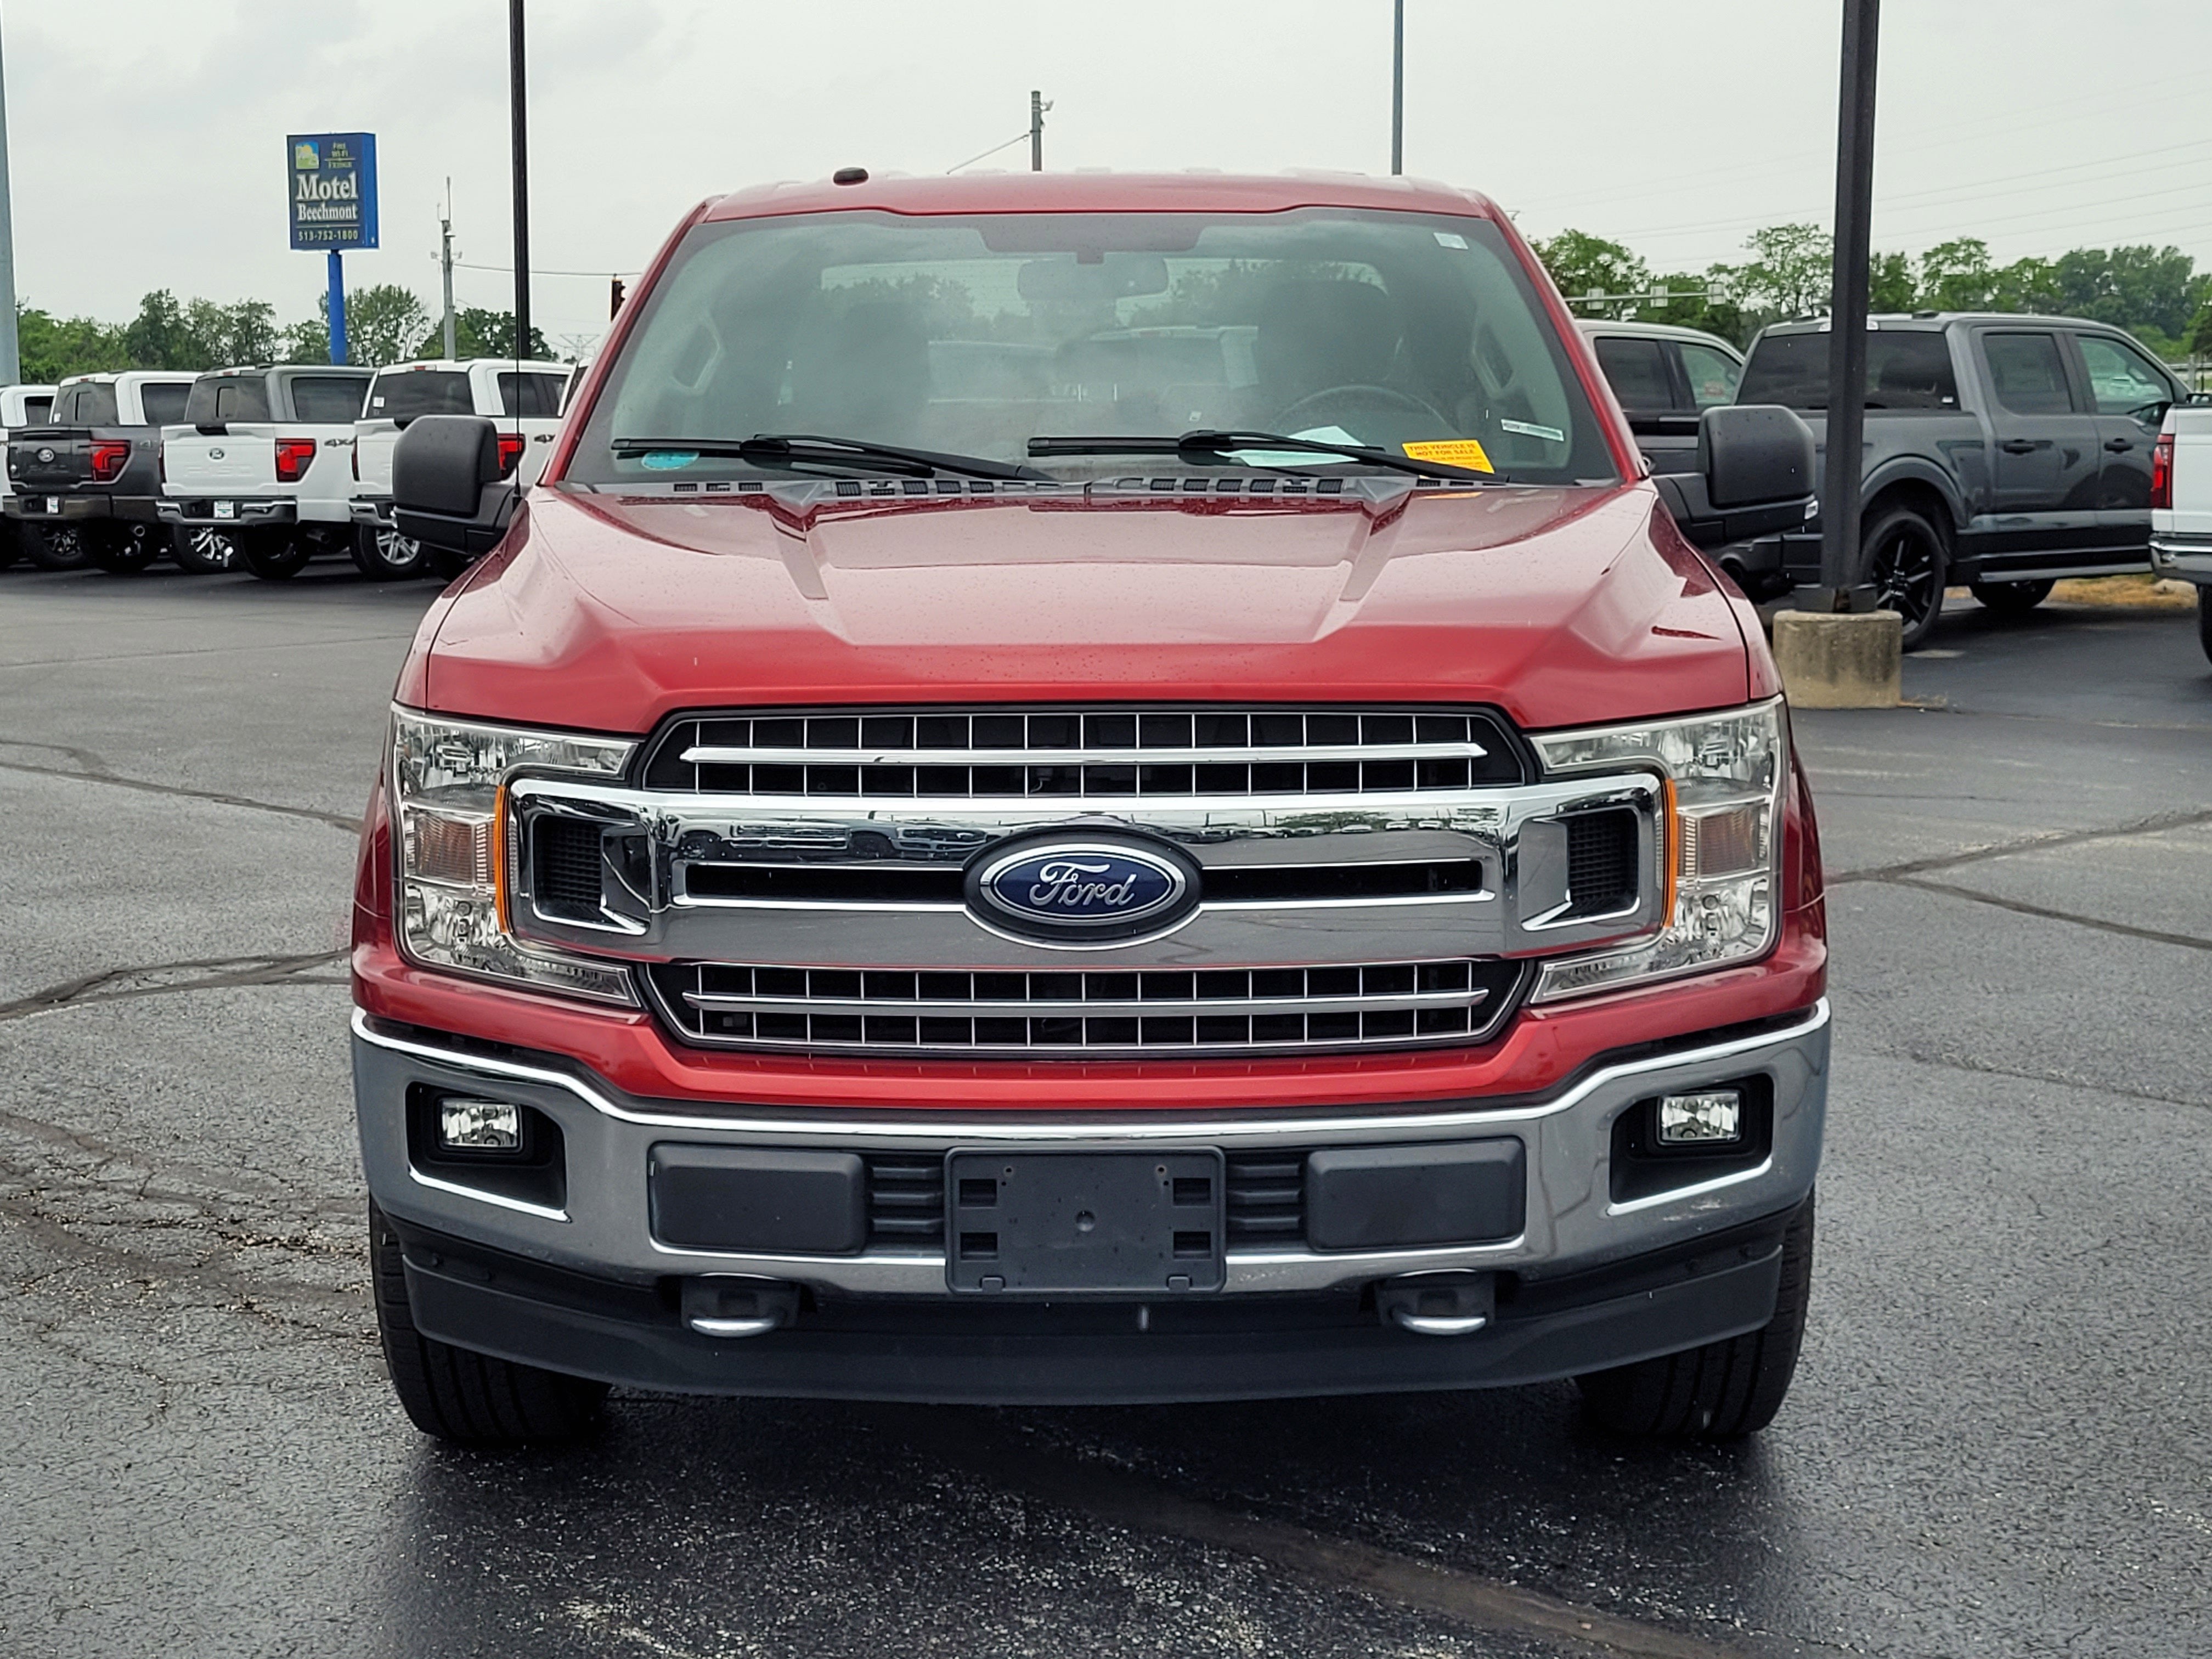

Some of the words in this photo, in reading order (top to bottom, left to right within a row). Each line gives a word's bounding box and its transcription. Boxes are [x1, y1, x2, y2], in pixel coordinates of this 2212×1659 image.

[296, 171, 359, 201] Motel
[297, 201, 358, 222] Beechmont
[1029, 862, 1137, 906] Ford
